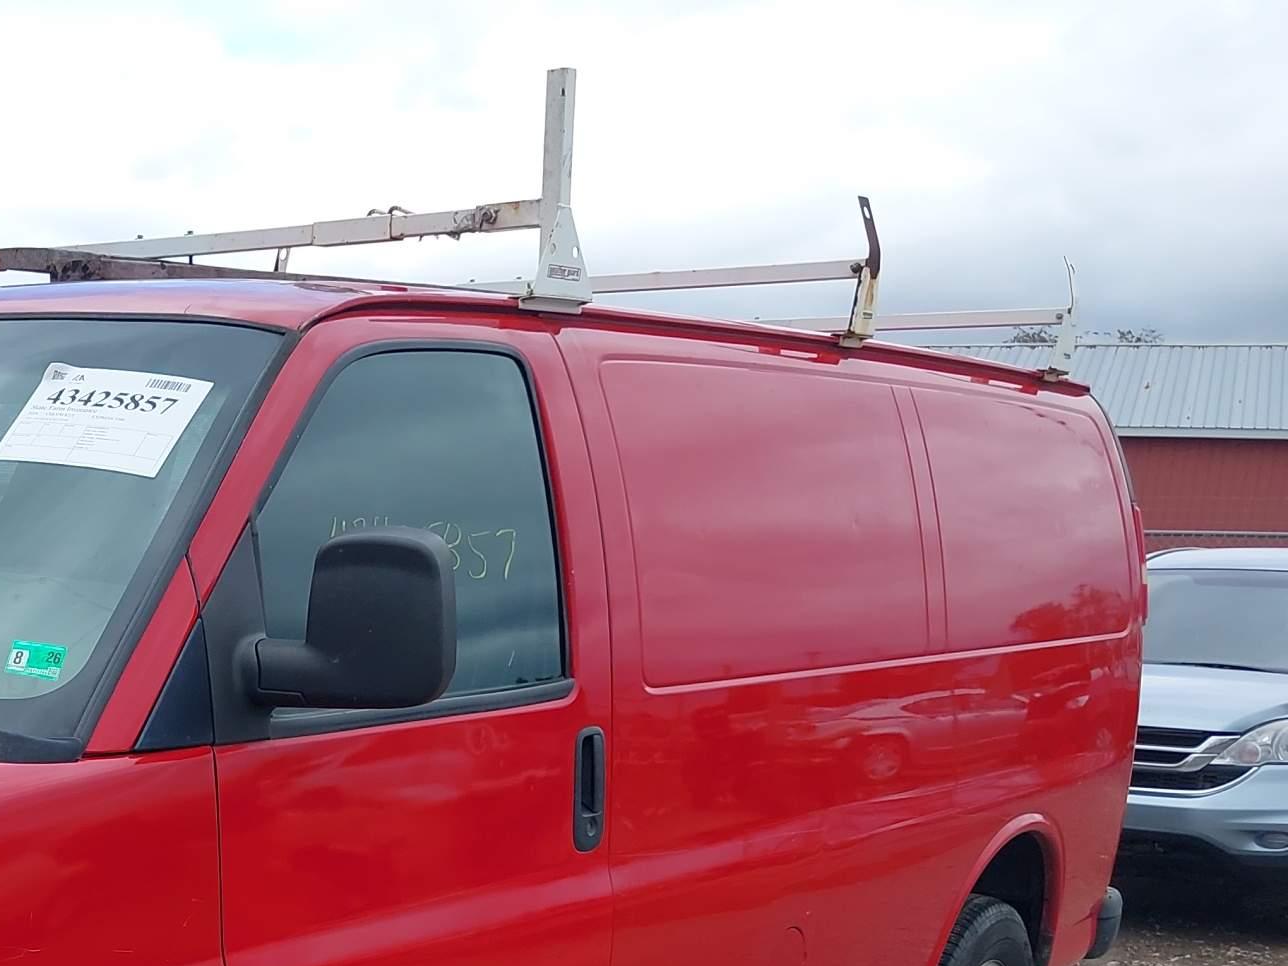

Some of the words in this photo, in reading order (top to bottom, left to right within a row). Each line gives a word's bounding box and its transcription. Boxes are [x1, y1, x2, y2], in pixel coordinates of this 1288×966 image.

[46, 387, 179, 415] 43425857
[13, 650, 24, 665] 8
[46, 651, 62, 665] 26
